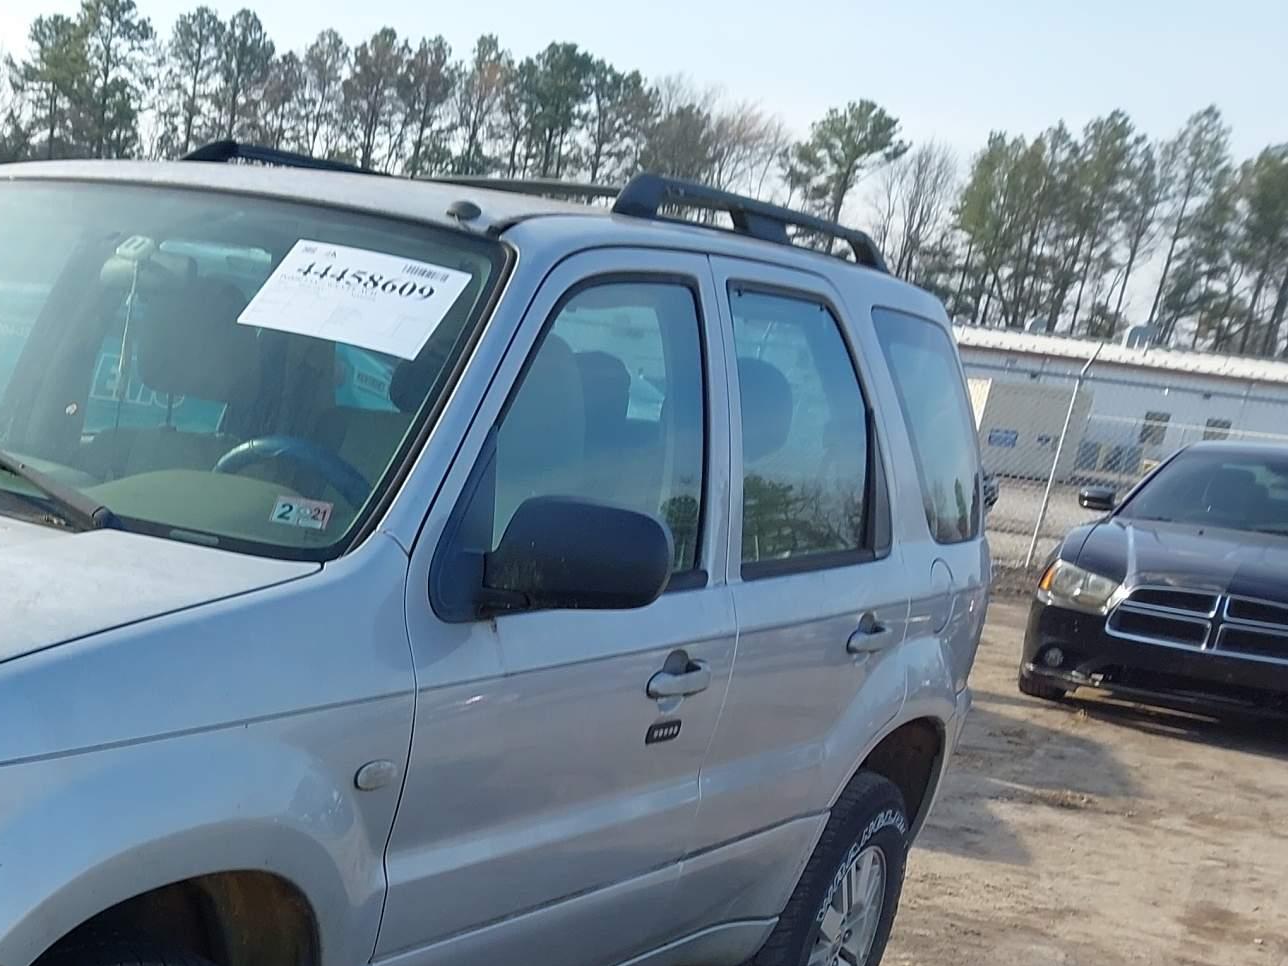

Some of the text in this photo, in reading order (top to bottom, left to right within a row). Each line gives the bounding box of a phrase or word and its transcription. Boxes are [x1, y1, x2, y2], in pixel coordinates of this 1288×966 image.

[297, 261, 435, 299] 44458609
[276, 503, 328, 521] 2 21
